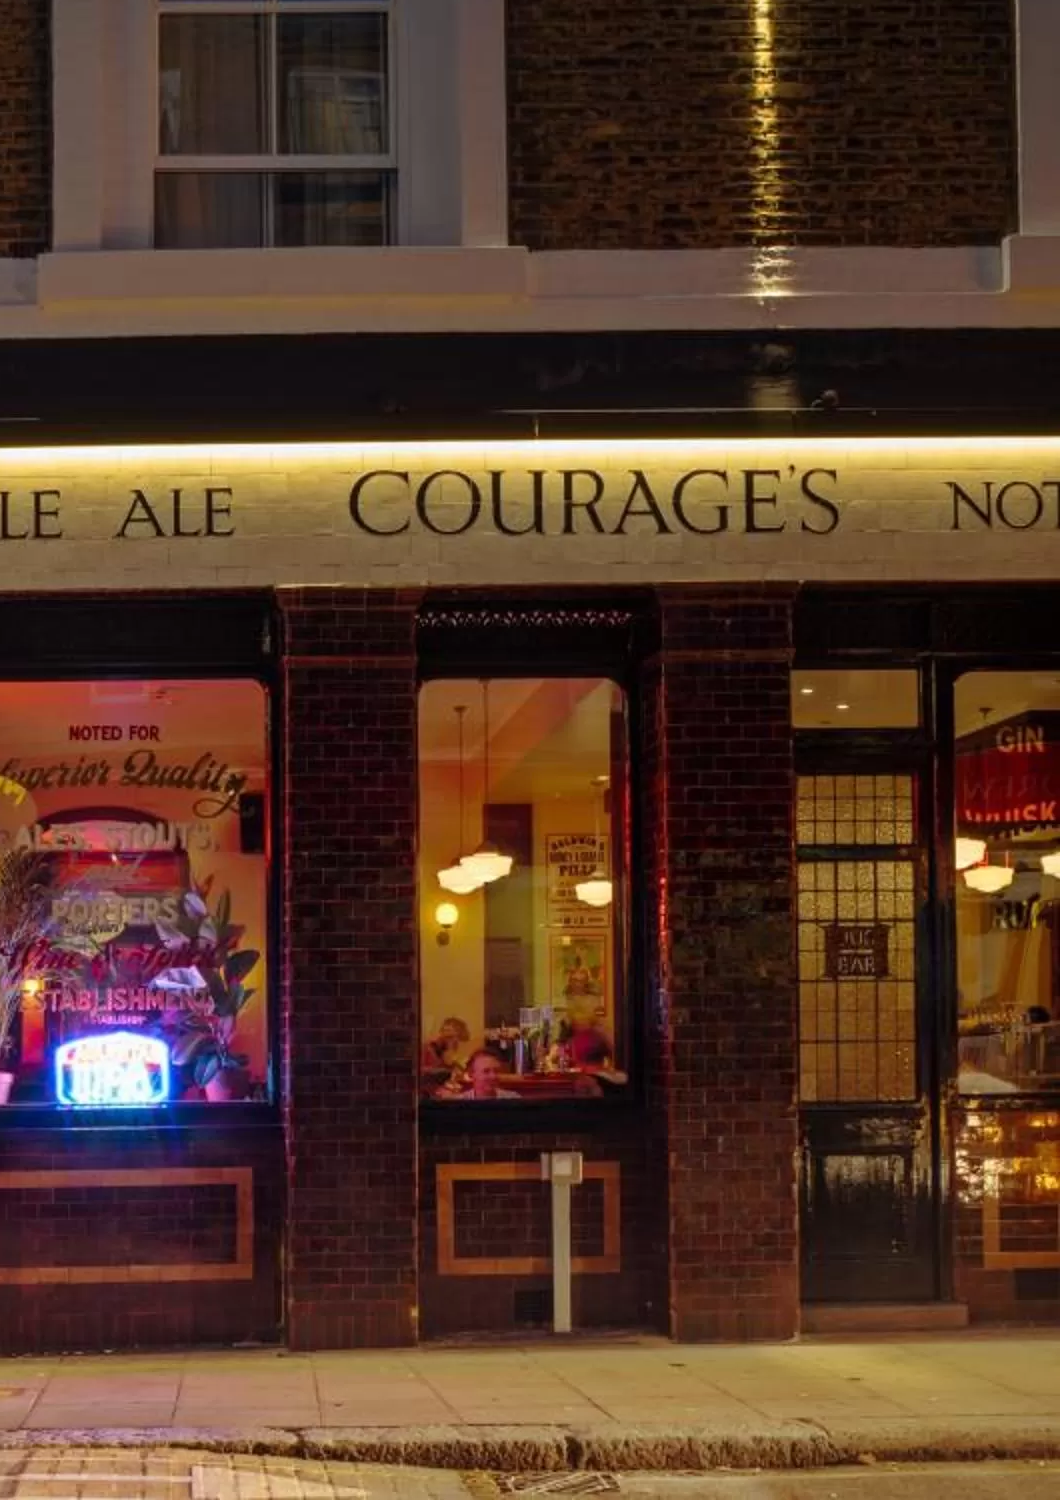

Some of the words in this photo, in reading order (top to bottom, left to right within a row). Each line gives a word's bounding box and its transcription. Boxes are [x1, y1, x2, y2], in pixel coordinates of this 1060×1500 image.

[115, 486, 237, 538] ALE
[348, 463, 840, 536] COURAGE'S
[69, 724, 123, 742] NOTED
[128, 724, 161, 742] FOR
[995, 725, 1045, 753] GIN
[120, 749, 247, 819] Quality
